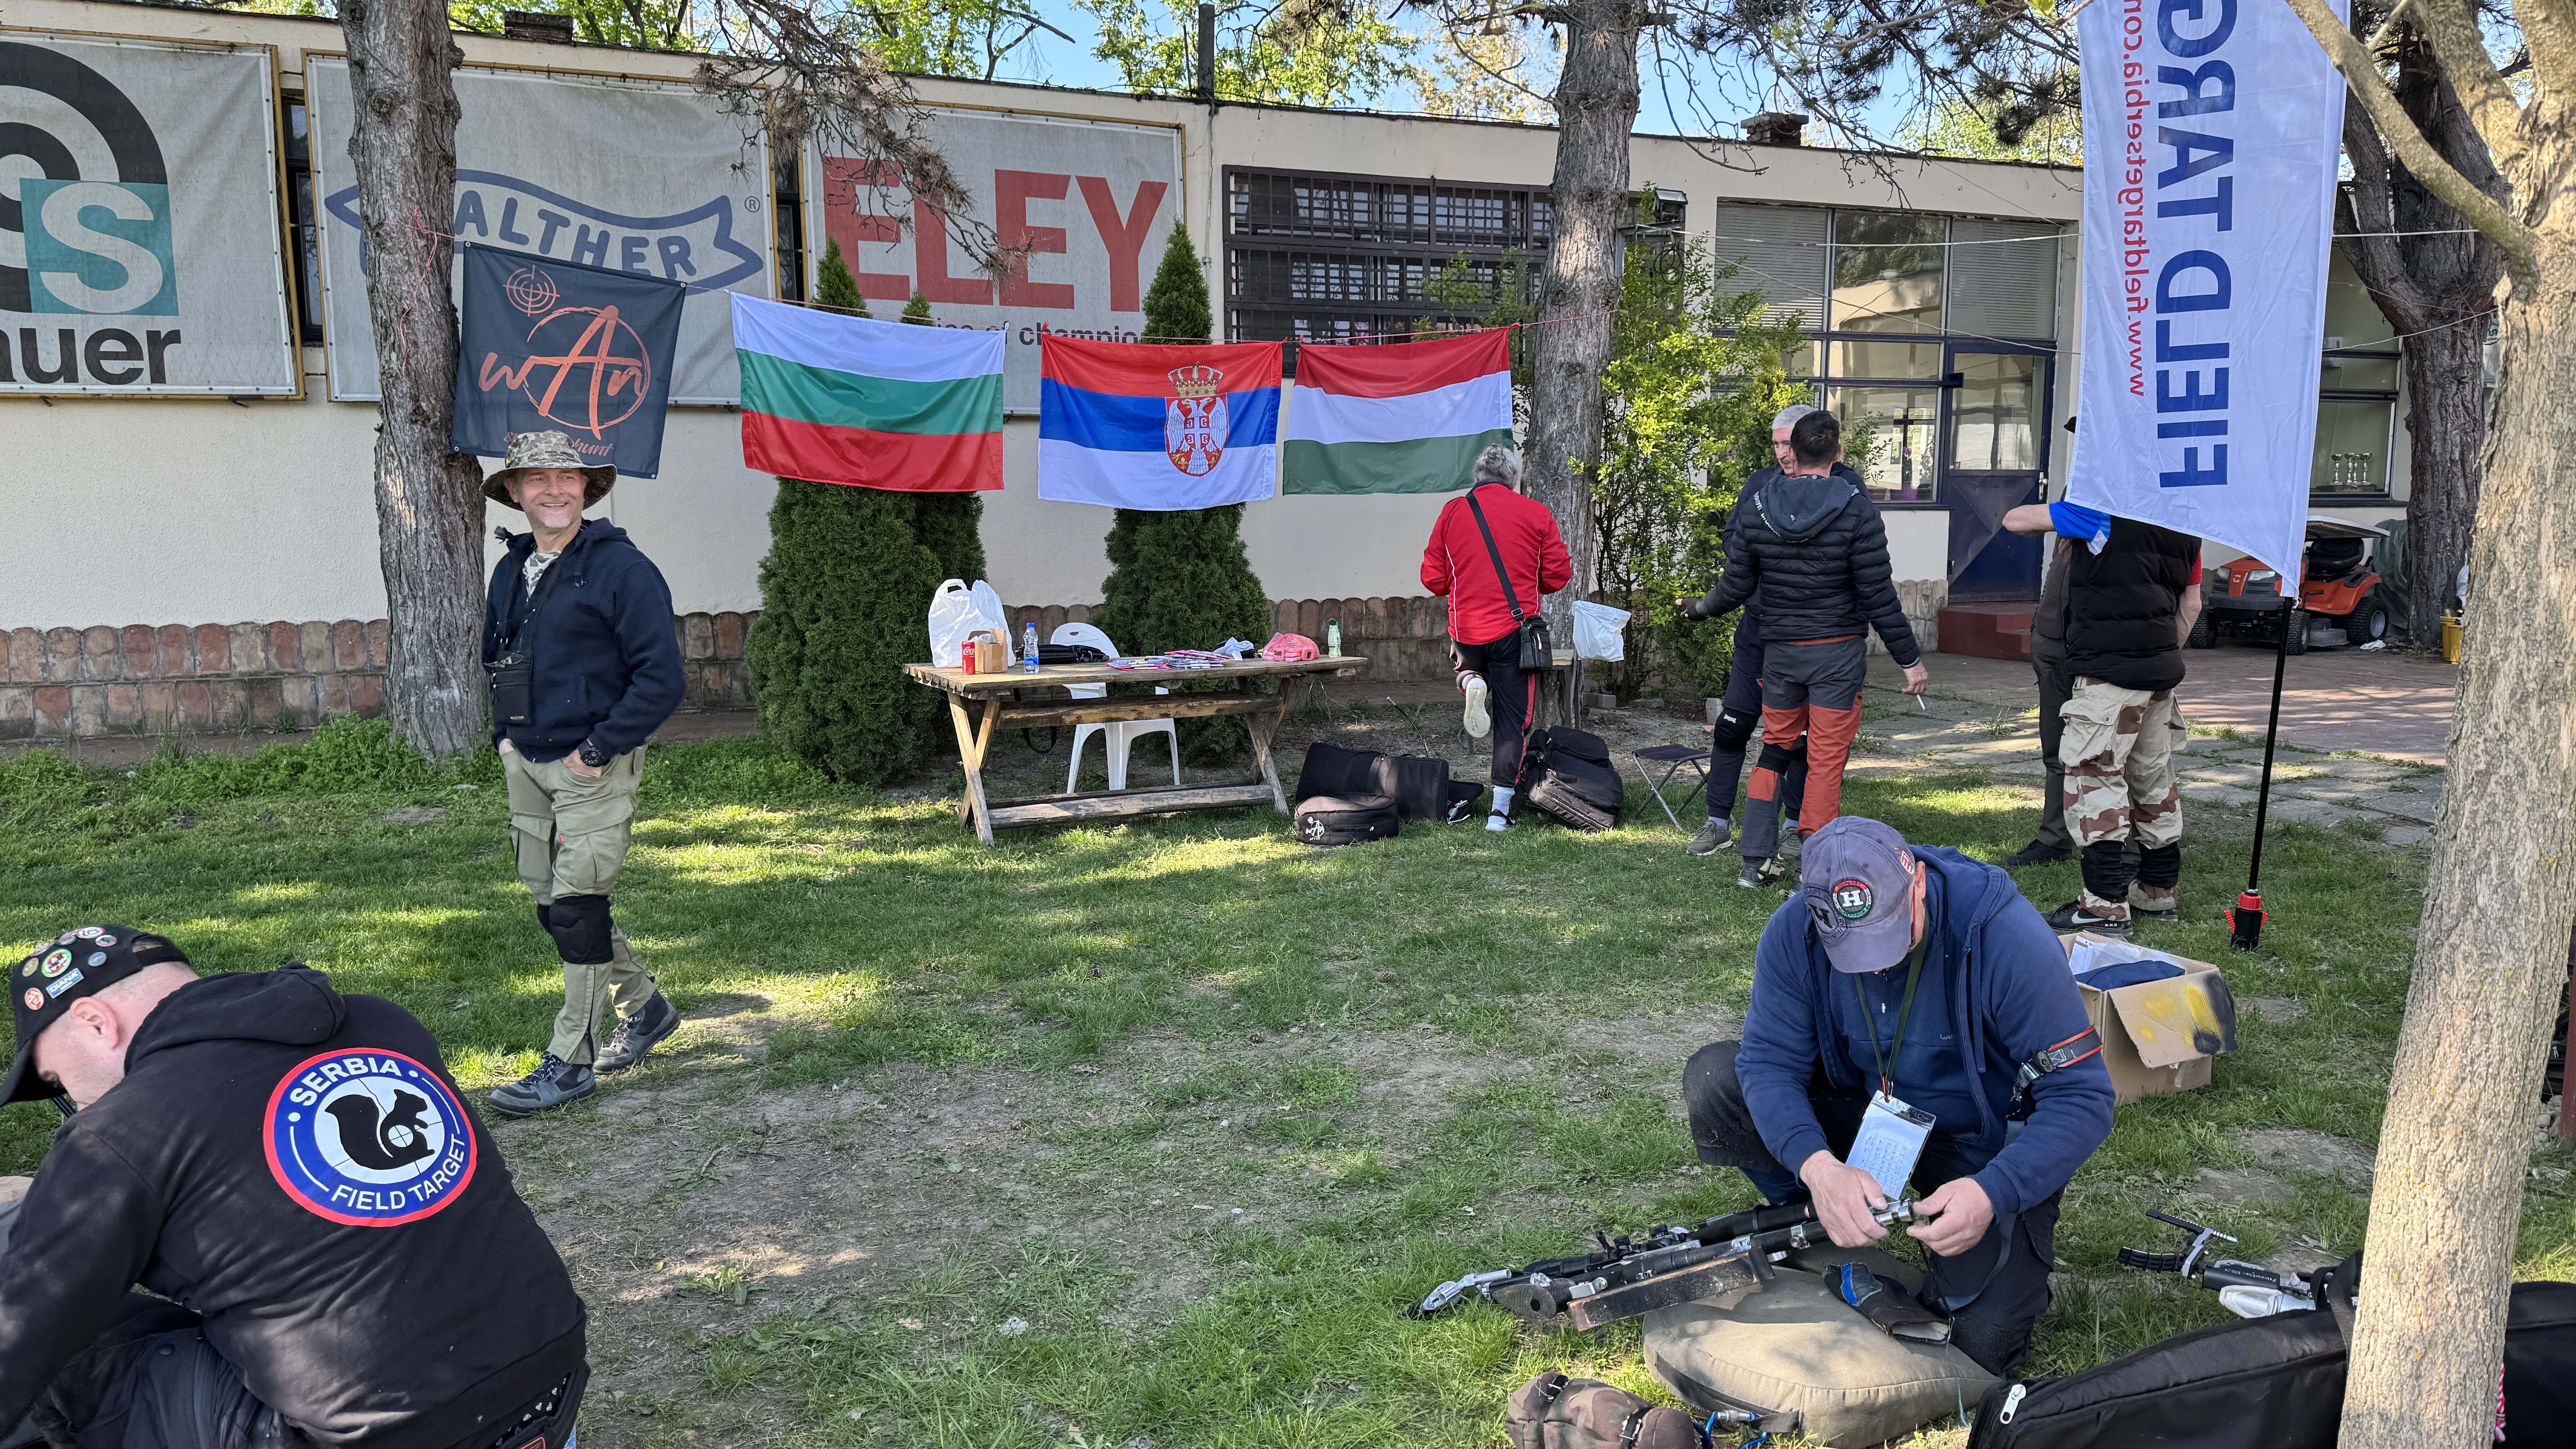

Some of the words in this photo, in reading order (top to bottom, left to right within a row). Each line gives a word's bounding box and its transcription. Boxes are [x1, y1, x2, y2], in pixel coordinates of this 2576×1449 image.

[455, 190, 697, 279] ALTHER
[823, 157, 1168, 312] ELEY
[1840, 890, 1863, 907] H
[290, 1057, 402, 1106] SERBIA
[331, 1184, 405, 1210] FIELD
[408, 1133, 465, 1202] TARGET
